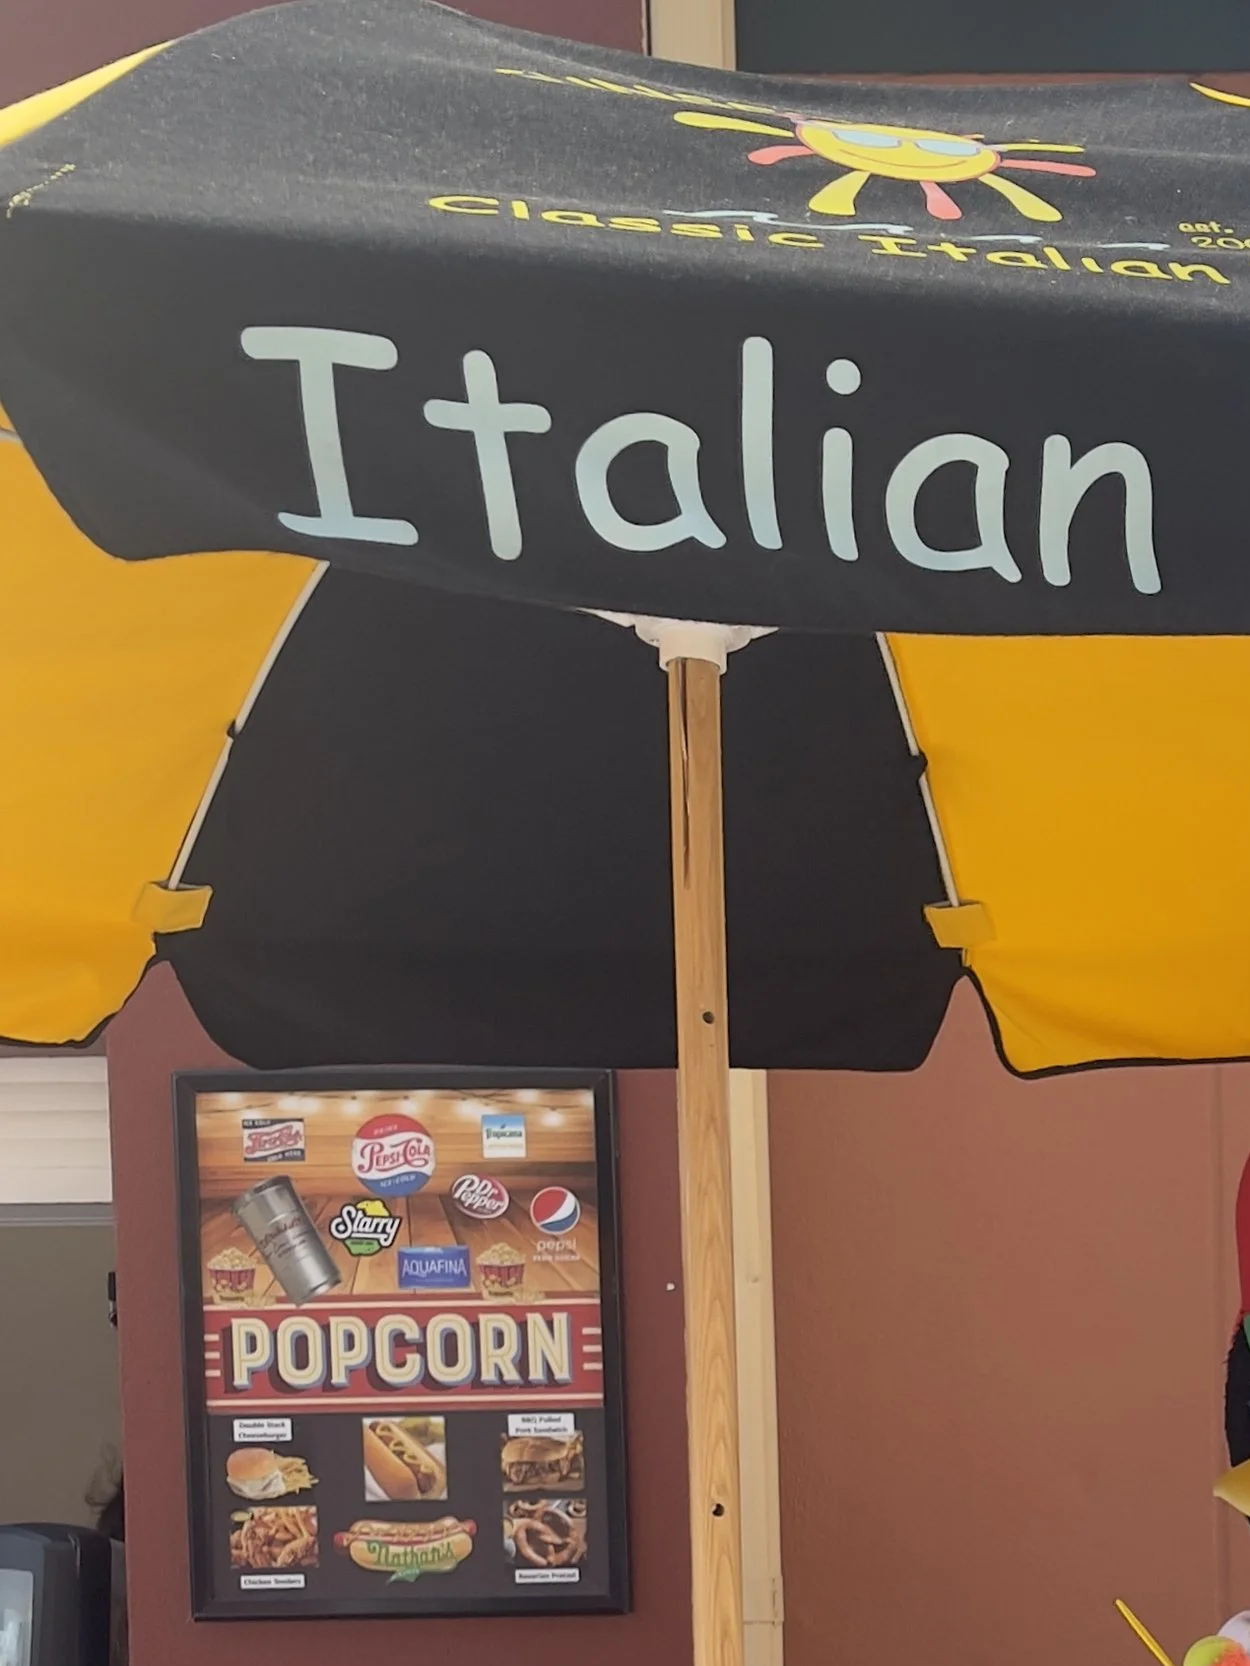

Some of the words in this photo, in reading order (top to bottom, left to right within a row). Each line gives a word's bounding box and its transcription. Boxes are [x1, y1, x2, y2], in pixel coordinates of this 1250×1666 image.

[427, 194, 825, 249] Classic
[857, 233, 1232, 285] Italian
[240, 326, 1162, 595] Italian
[486, 1127, 523, 1140] Tropicana
[478, 1178, 499, 1198] Dr
[330, 1204, 400, 1248] Starry
[536, 1237, 577, 1252] pepsi
[401, 1257, 468, 1278] AQUAFINA
[230, 1311, 573, 1389] POPCORN
[365, 1539, 455, 1567] Nathan's
